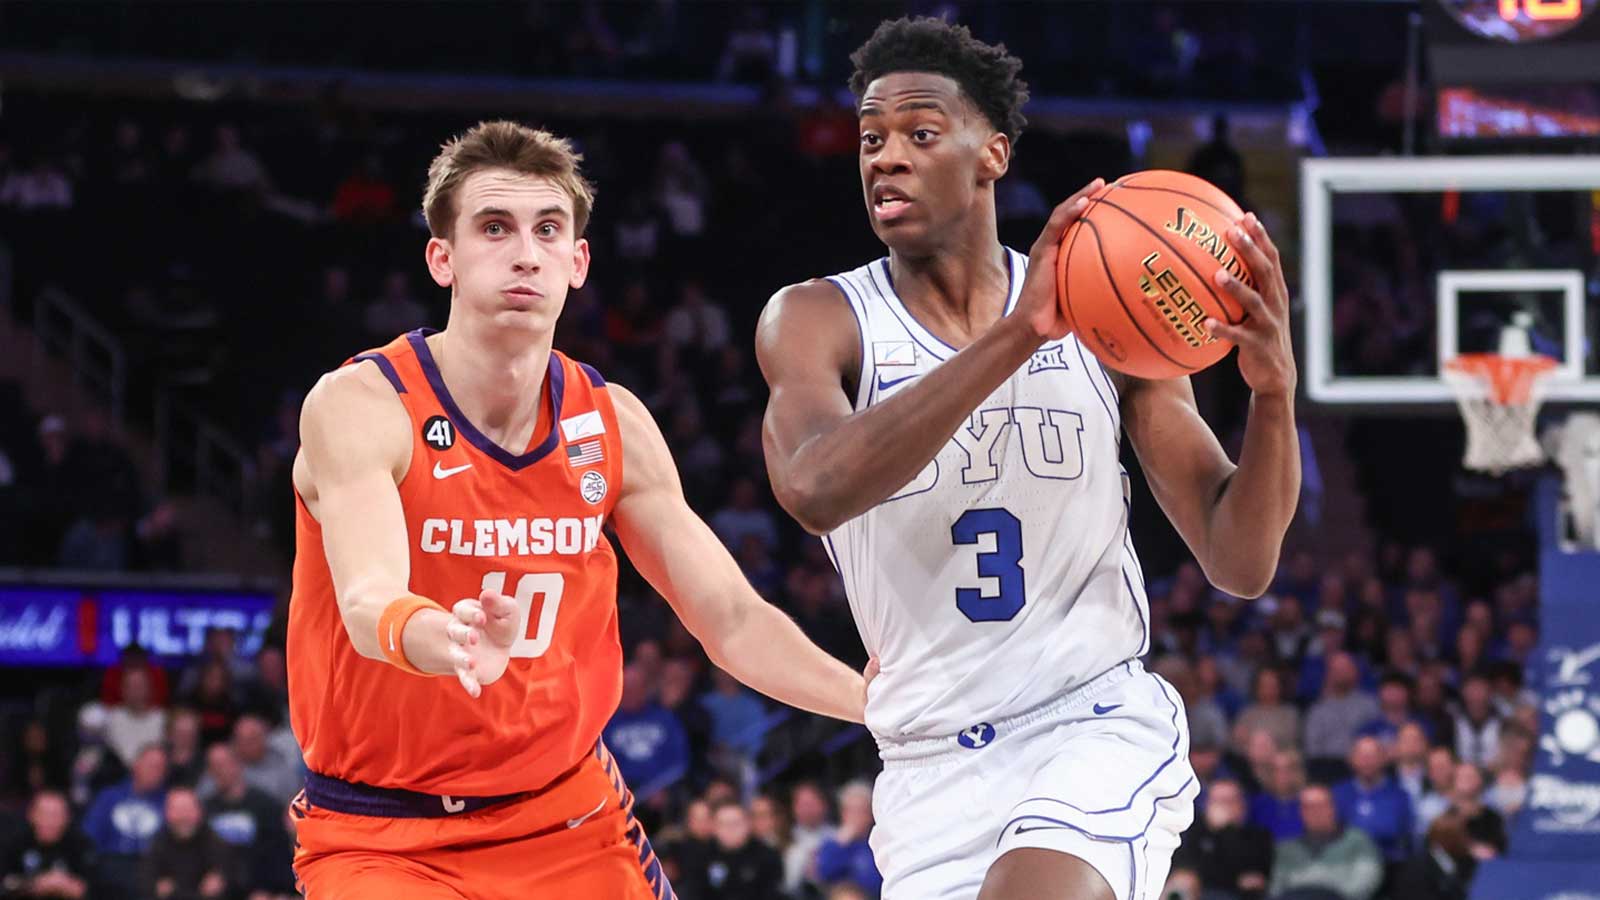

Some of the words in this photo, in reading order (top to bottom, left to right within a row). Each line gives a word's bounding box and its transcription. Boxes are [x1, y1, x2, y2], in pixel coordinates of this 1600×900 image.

[1164, 206, 1252, 290] SPALDI
[426, 419, 452, 446] 41
[880, 407, 1084, 505] YU
[420, 513, 604, 557] CLEMSON
[951, 507, 1026, 622] 3
